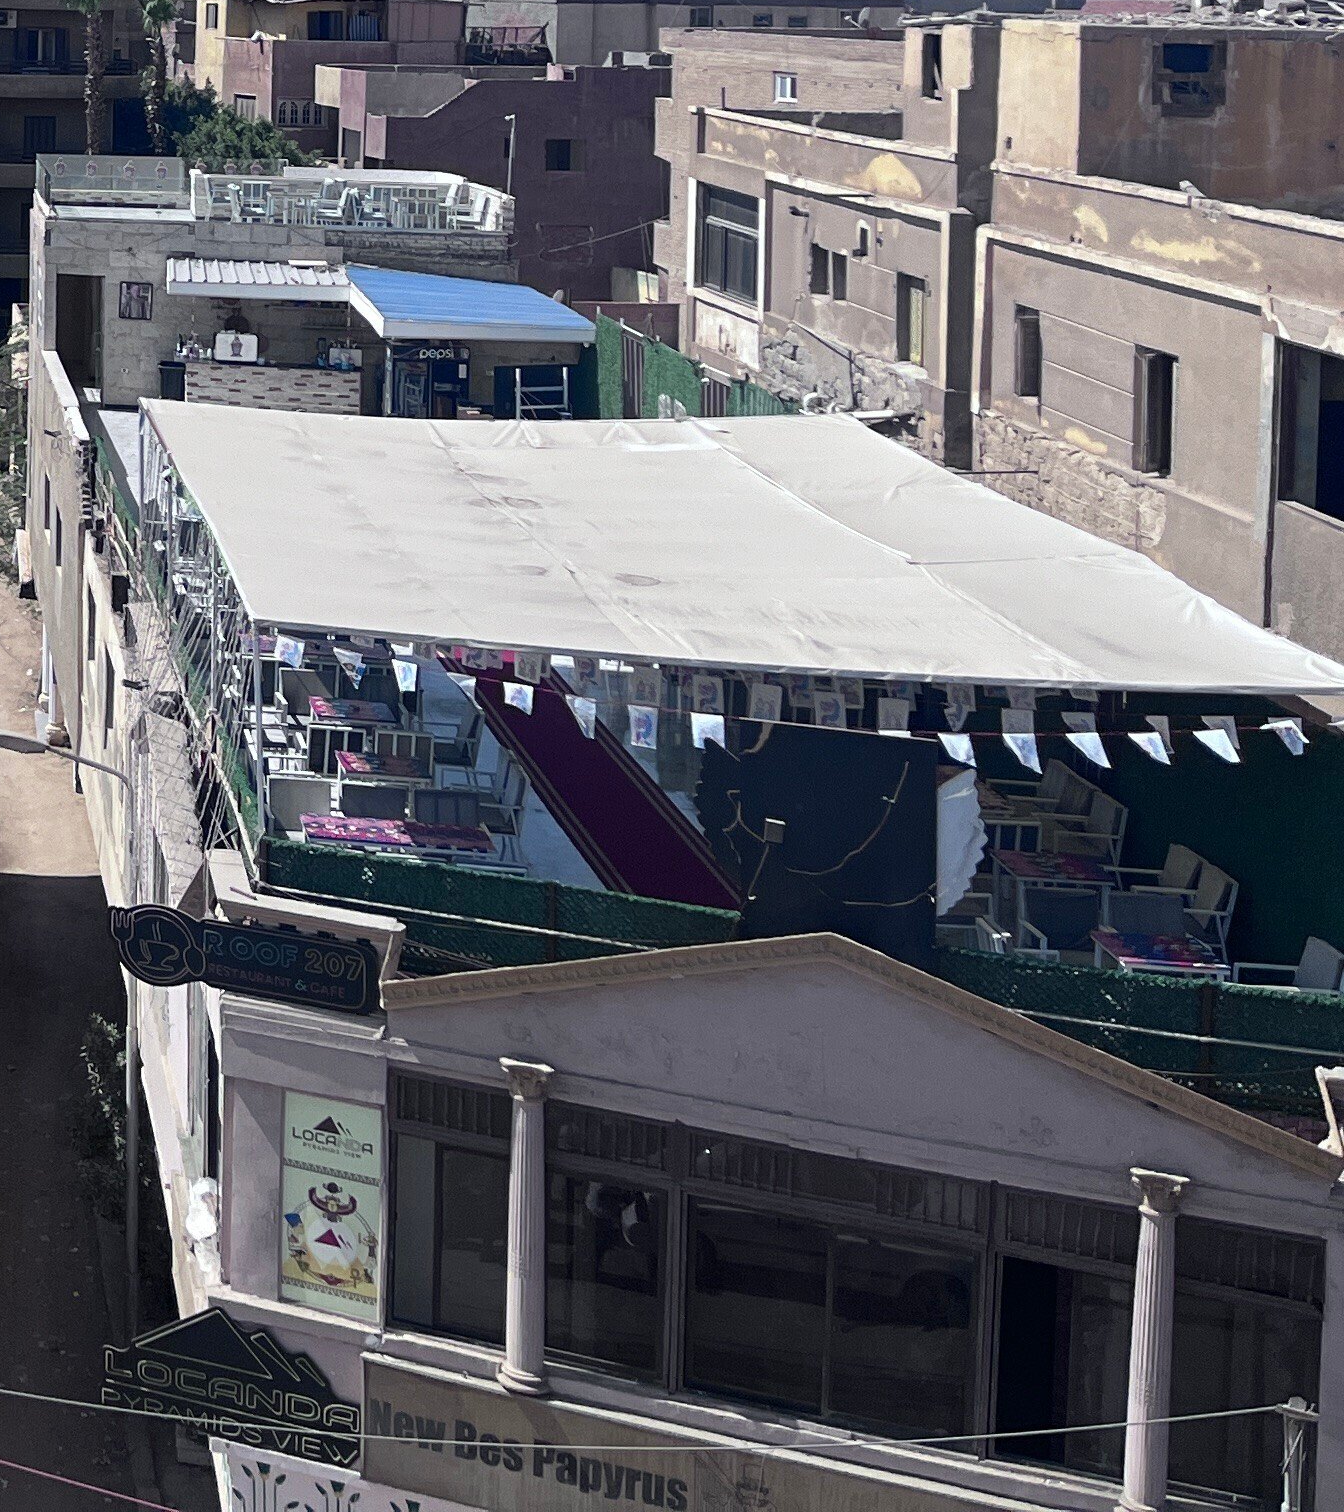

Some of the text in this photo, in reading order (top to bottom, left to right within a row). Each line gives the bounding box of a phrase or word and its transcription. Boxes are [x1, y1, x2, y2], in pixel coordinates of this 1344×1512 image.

[419, 348, 455, 360] pepsi
[304, 949, 362, 981] 207
[294, 978, 308, 992] &
[292, 1126, 374, 1156] LOCANDA
[104, 1349, 360, 1433] LOCANDA
[101, 1387, 359, 1464] PYRAMIDS VIEW
[369, 1397, 689, 1511] New Bes Papyrus
